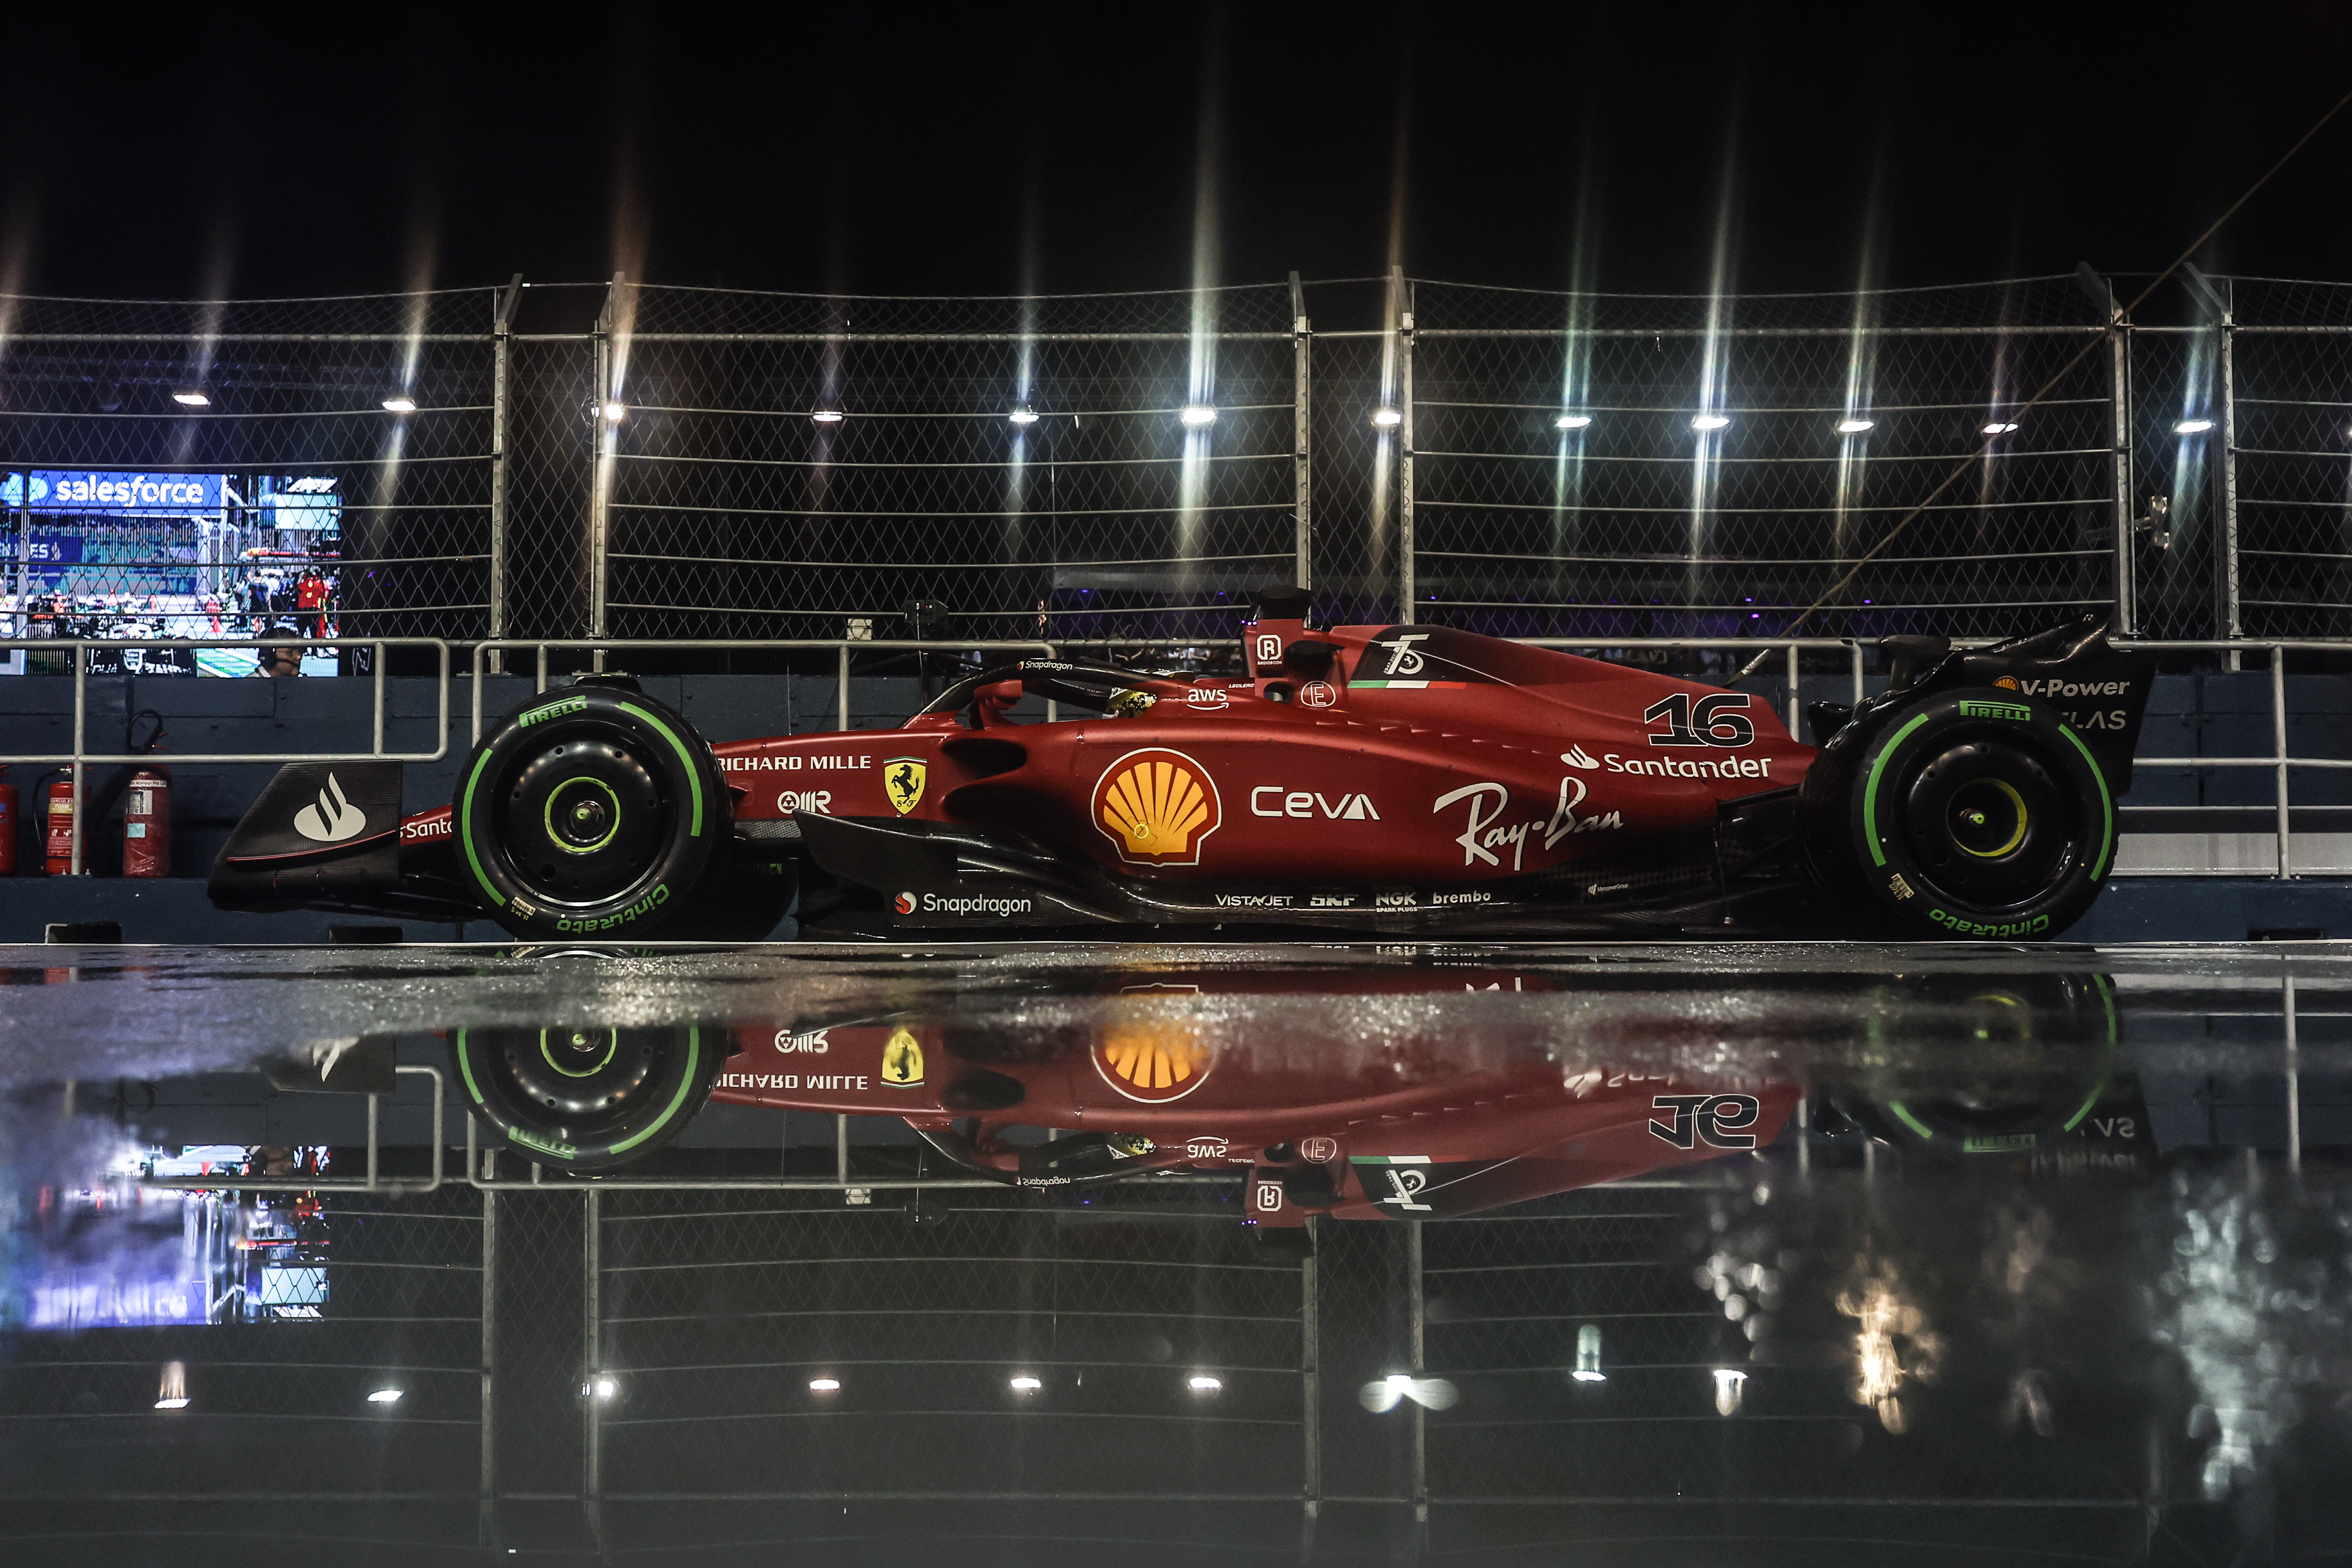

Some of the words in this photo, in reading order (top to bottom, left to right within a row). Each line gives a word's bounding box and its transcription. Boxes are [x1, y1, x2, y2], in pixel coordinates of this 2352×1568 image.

[56, 474, 204, 507] salesforce
[1025, 661, 1073, 671] Snapdragon
[1188, 689, 1228, 703] aws
[2021, 679, 2130, 698] V-Power
[519, 695, 588, 728] PIRELLI
[1959, 700, 2031, 721] PIRELLI
[1644, 693, 1755, 748] 16
[718, 756, 802, 771] RICHARD
[810, 755, 871, 770] MILLE
[1603, 753, 1772, 778] Santander
[923, 893, 1032, 917] Snapdragon
[1310, 894, 1359, 906] SKF
[1376, 892, 1417, 906] NGK
[1433, 891, 1491, 905] brembo
